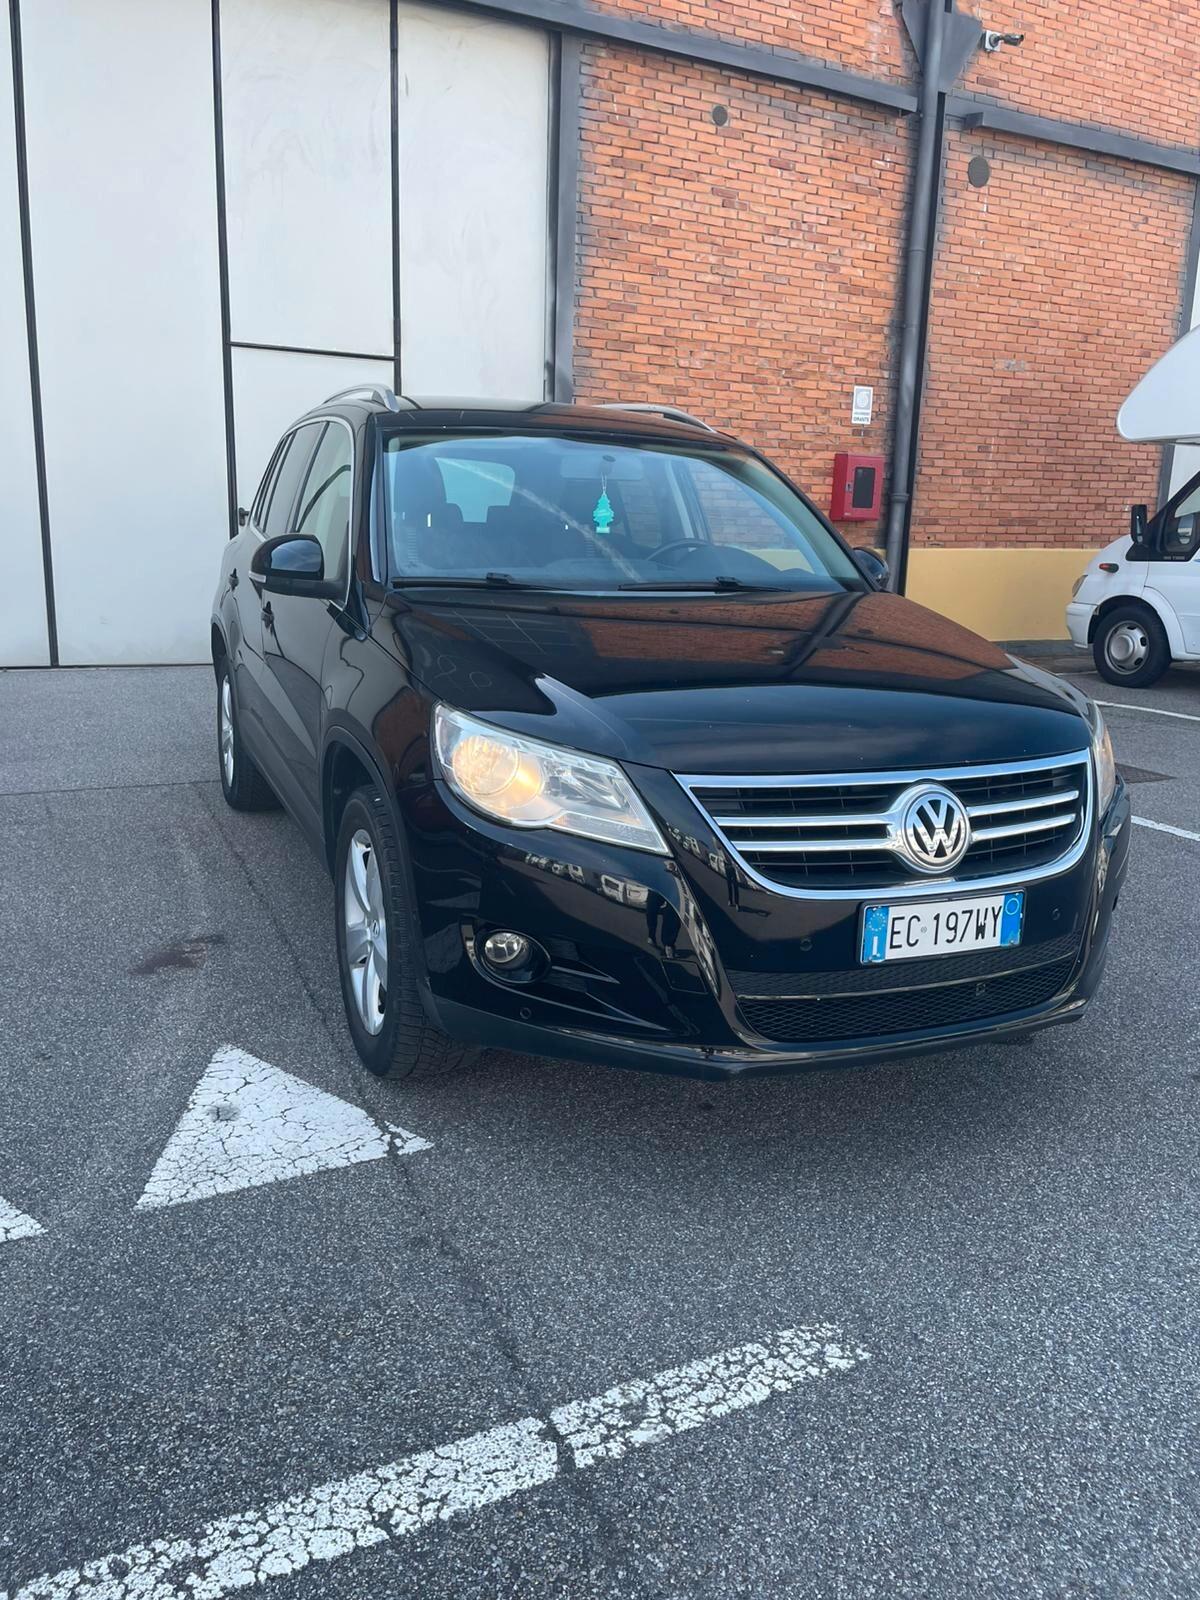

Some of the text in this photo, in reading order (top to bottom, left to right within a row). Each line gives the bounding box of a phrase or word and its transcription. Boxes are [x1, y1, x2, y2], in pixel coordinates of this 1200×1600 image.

[904, 789, 967, 865] VW
[872, 936, 878, 956] I
[889, 905, 1003, 949] EC 197WY
